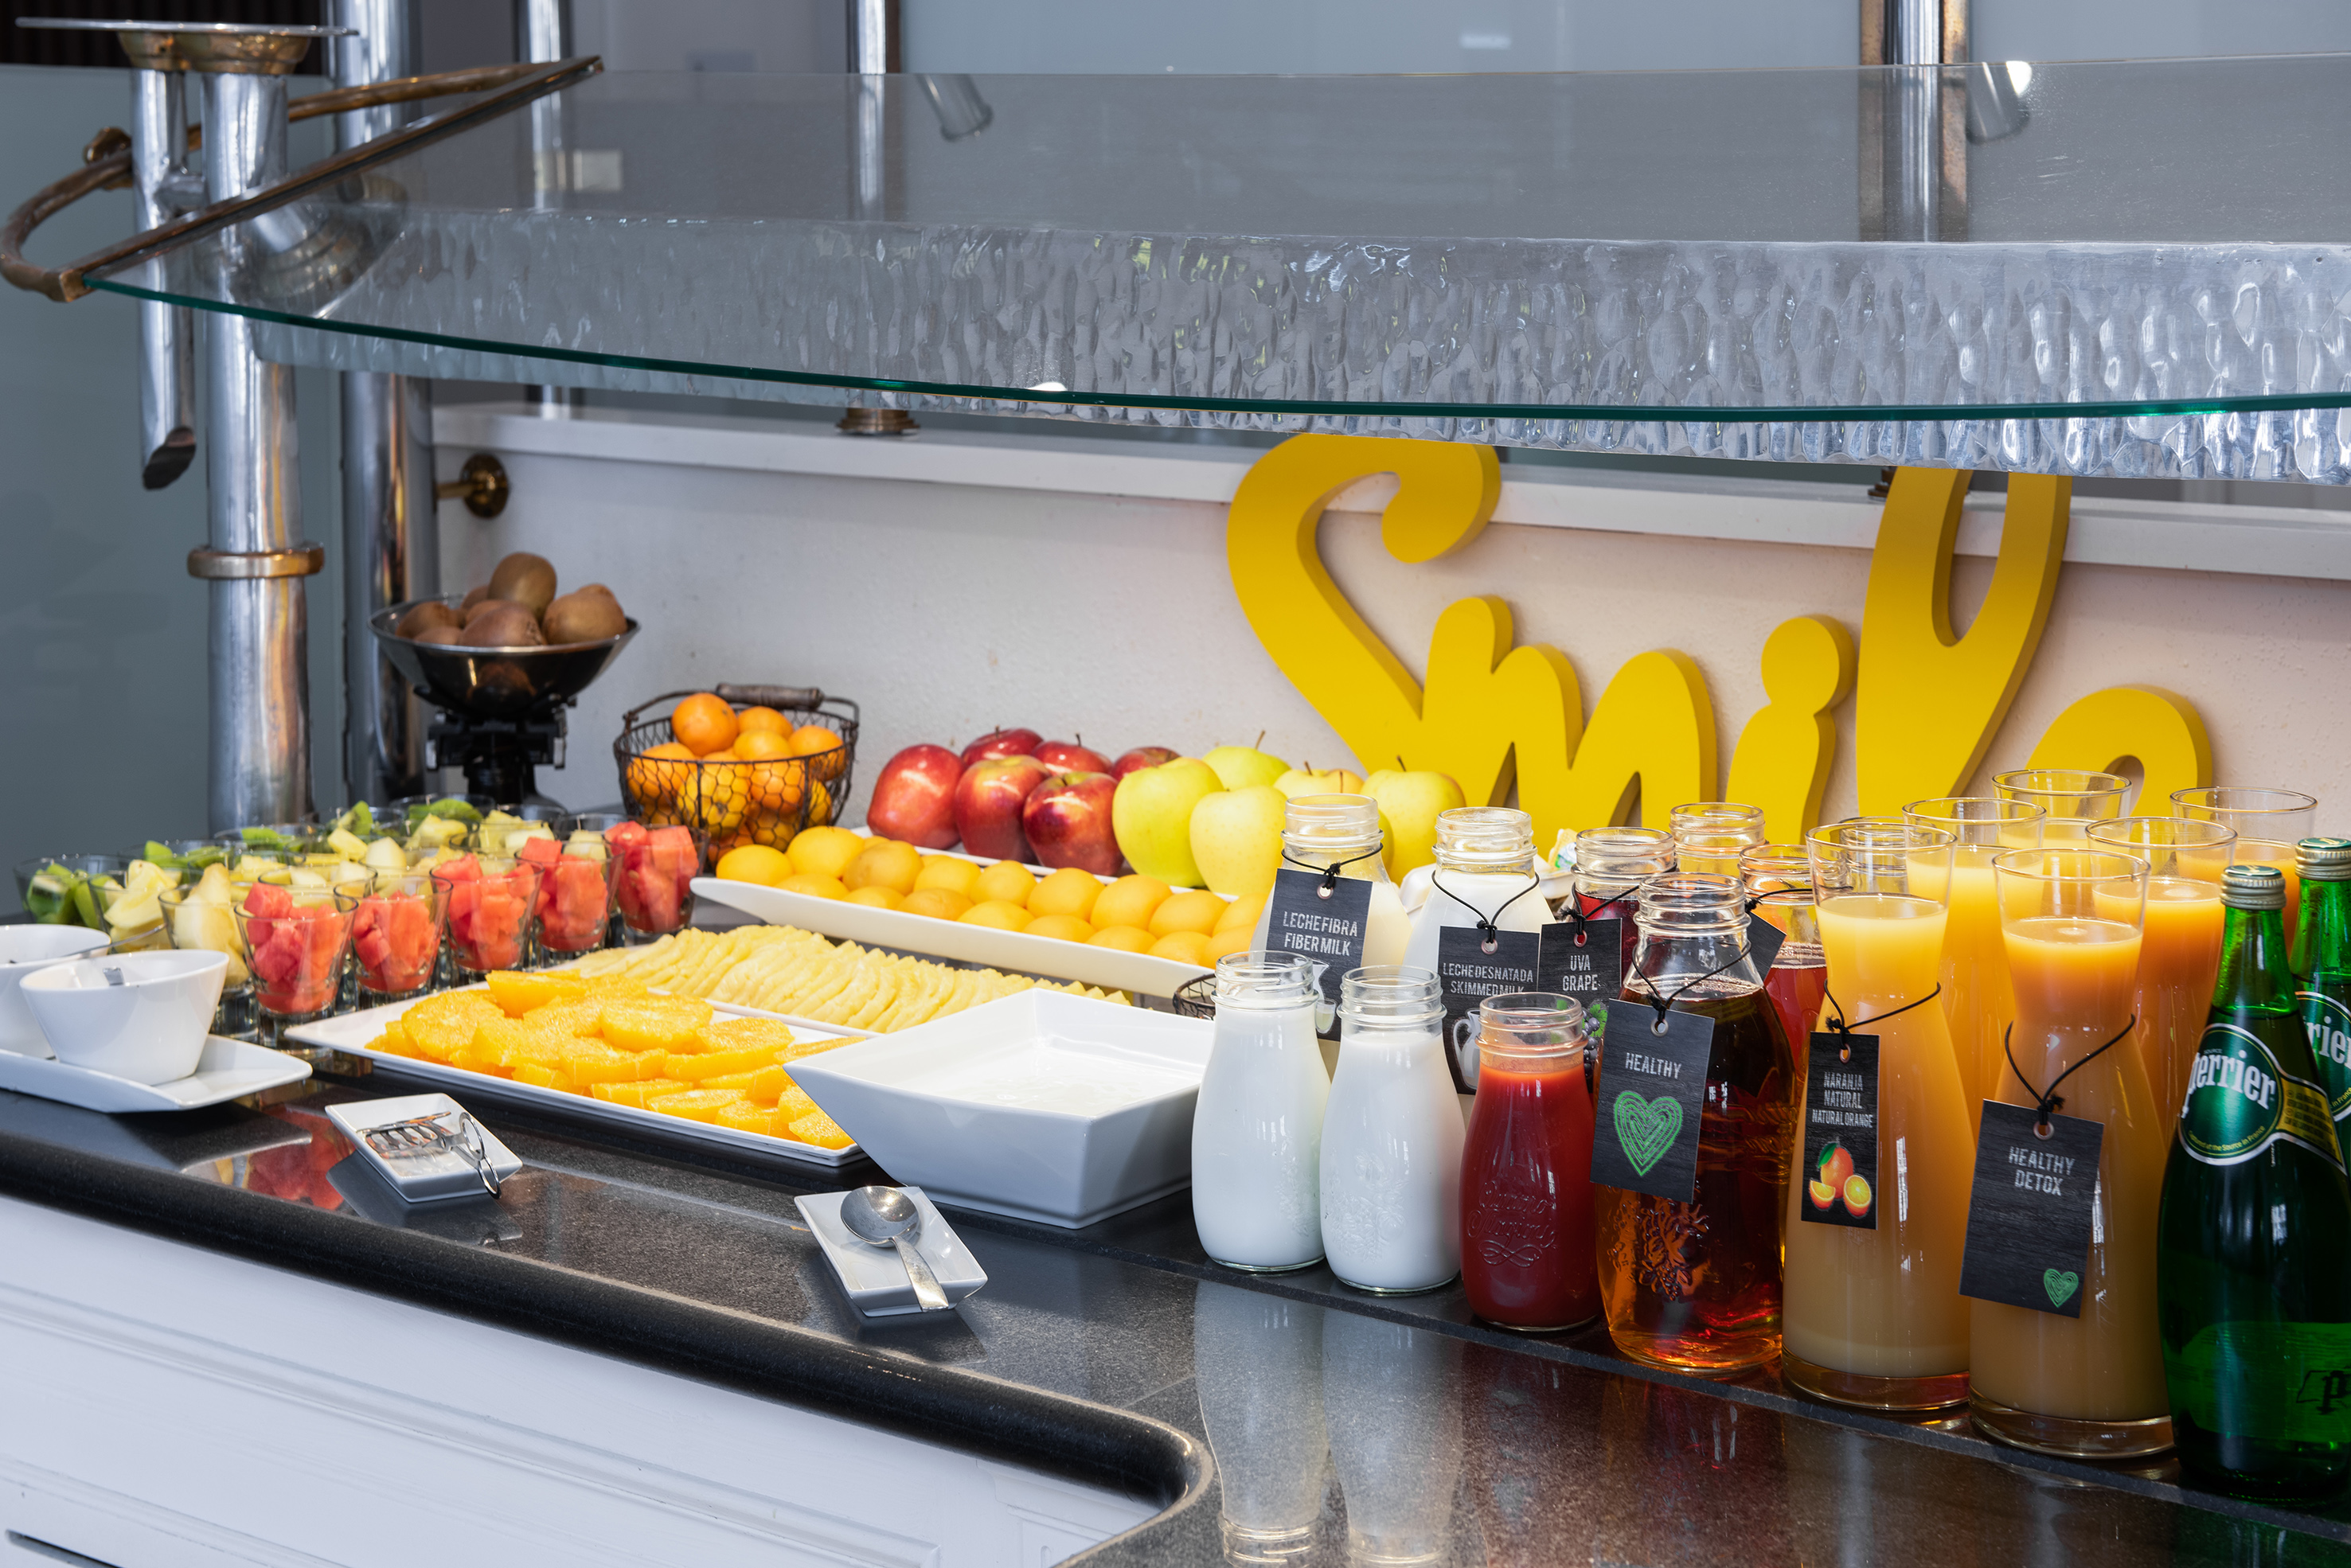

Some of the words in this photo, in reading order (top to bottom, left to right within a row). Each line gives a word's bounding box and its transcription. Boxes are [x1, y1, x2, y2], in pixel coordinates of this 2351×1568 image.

[1283, 911, 1321, 931] LECHE
[1322, 917, 1357, 937] FIBRA
[1284, 933, 1319, 952] FIBER
[1321, 938, 1351, 956] MILK
[1443, 962, 1474, 978] LECHE
[1475, 965, 1533, 982] DESNATADA
[1570, 955, 1591, 971] UVA
[1451, 981, 1498, 997] SKIMMED
[1562, 974, 1598, 992] GRAPE
[1625, 1052, 1682, 1079] HEALTHY
[1823, 1071, 1863, 1091] NARANJA
[1824, 1090, 1863, 1109] NATURAL
[1812, 1109, 1844, 1125] NATURAL
[1845, 1112, 1873, 1128] ORANGE
[2222, 1141, 2243, 1151] Source
[2009, 1146, 2076, 1176] HEALTHY
[2014, 1169, 2064, 1196] DETOX
